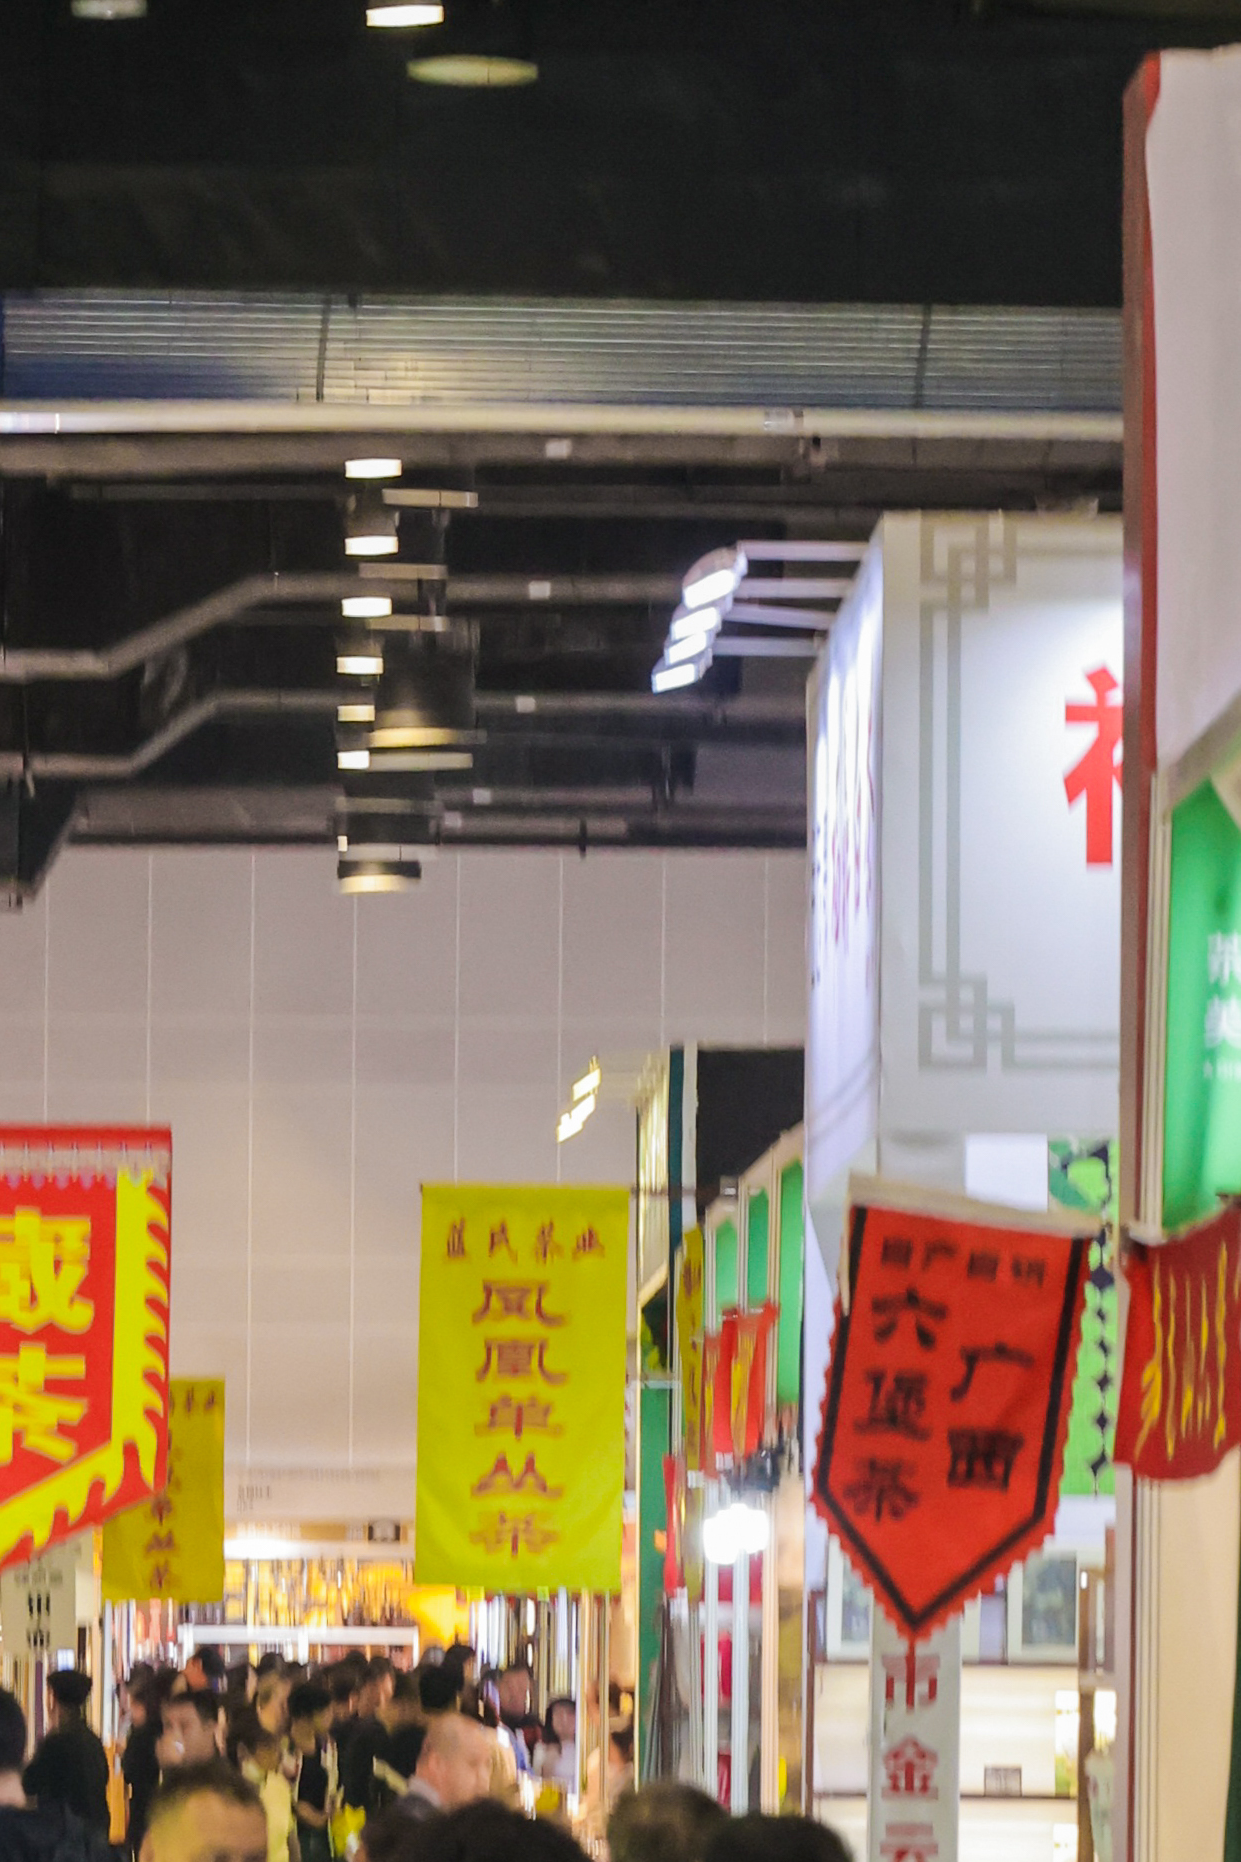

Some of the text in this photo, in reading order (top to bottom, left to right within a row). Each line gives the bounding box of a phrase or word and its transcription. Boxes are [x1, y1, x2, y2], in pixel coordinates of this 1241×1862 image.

[844, 1289, 950, 1524] 六堡茶
[949, 1342, 1036, 1493] 广西
